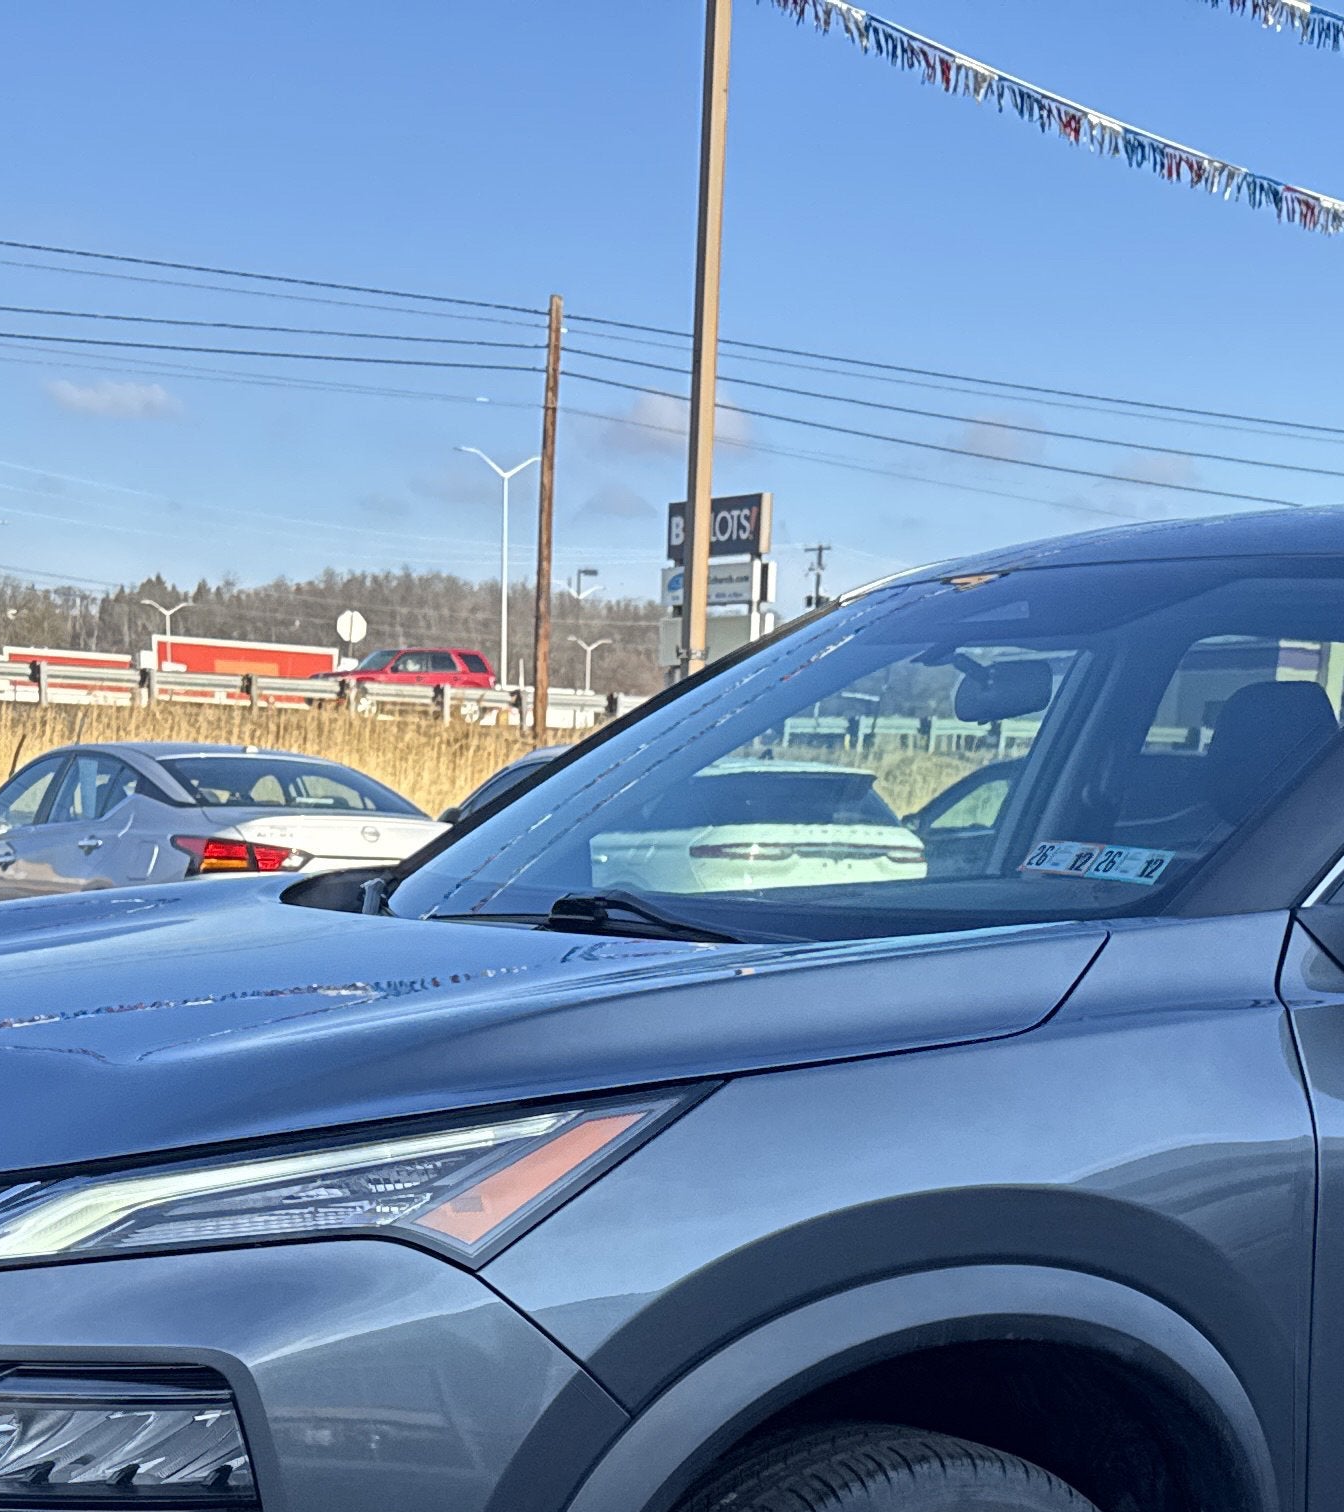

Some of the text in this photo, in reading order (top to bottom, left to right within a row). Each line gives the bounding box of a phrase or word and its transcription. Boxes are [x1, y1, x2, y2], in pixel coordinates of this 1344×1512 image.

[710, 506, 759, 542] LOTS!
[1026, 844, 1094, 871] 26 12
[1094, 850, 1164, 879] 26 12
